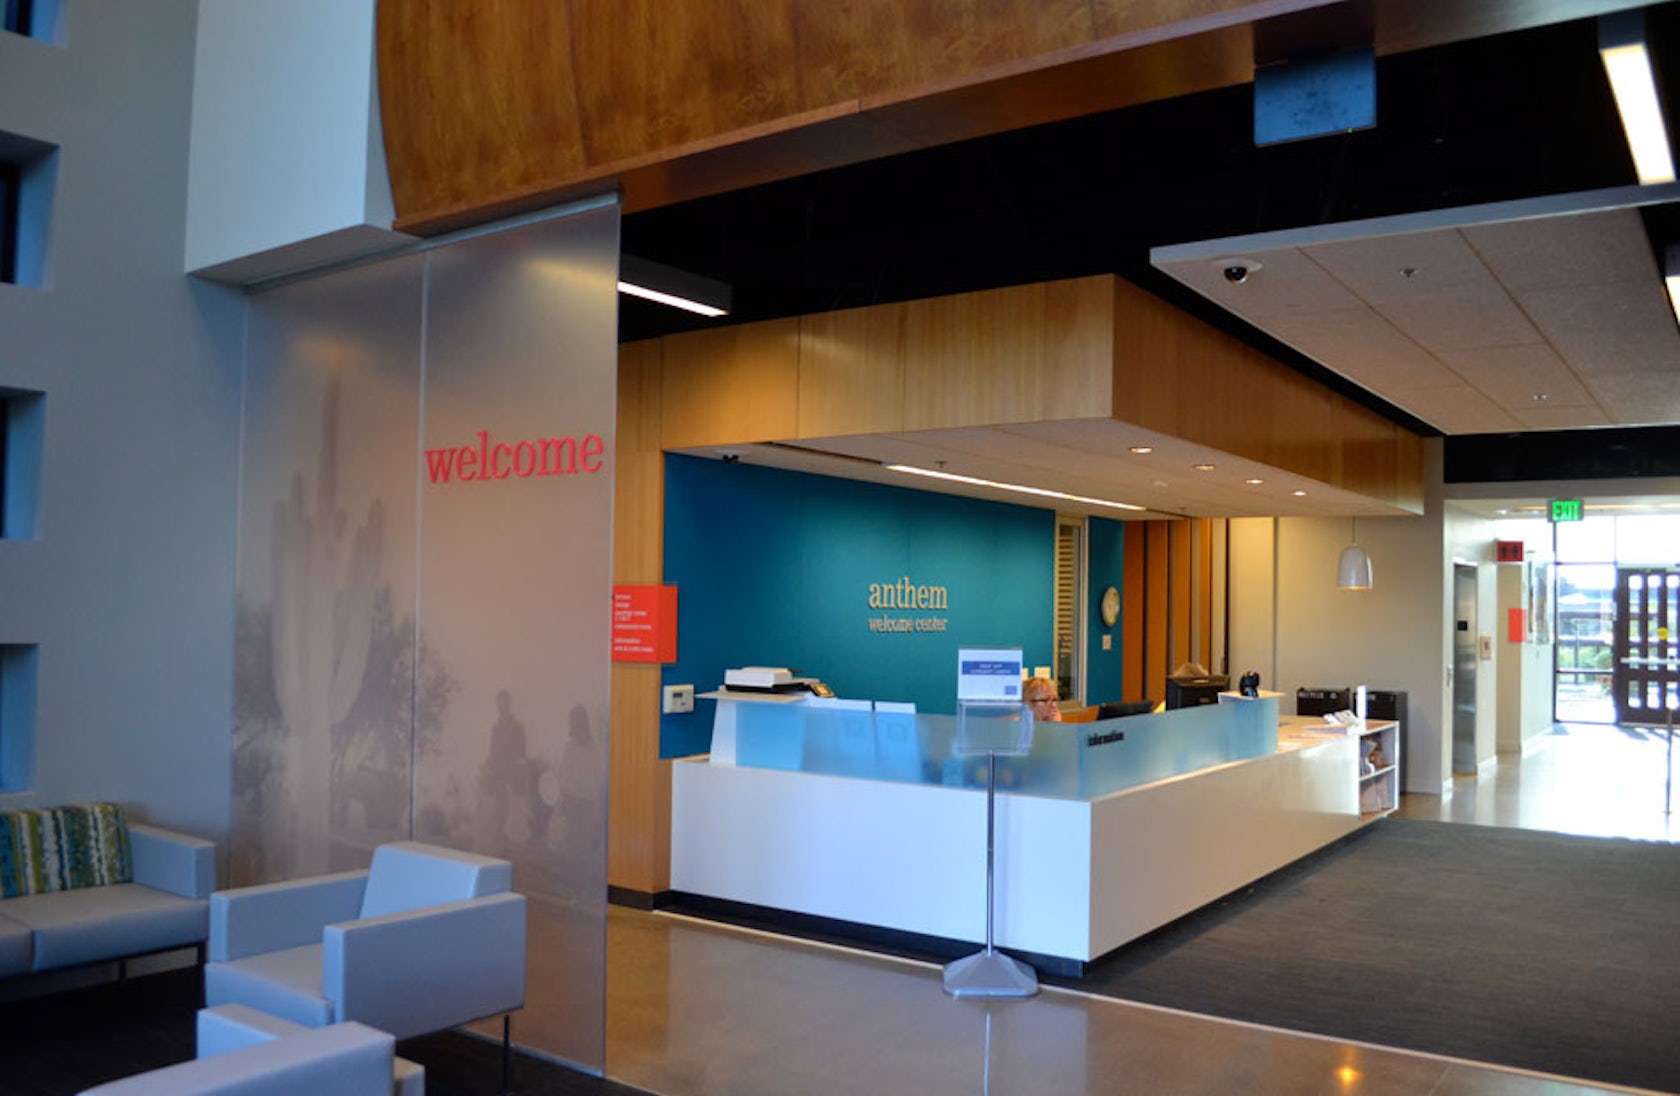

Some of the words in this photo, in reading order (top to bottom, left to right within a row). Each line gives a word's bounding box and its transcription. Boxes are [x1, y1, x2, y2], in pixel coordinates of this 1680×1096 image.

[424, 429, 604, 485] welcome
[1552, 500, 1580, 521] EXIT
[868, 576, 948, 609] anthem
[868, 613, 913, 633] welcome
[915, 614, 948, 633] center
